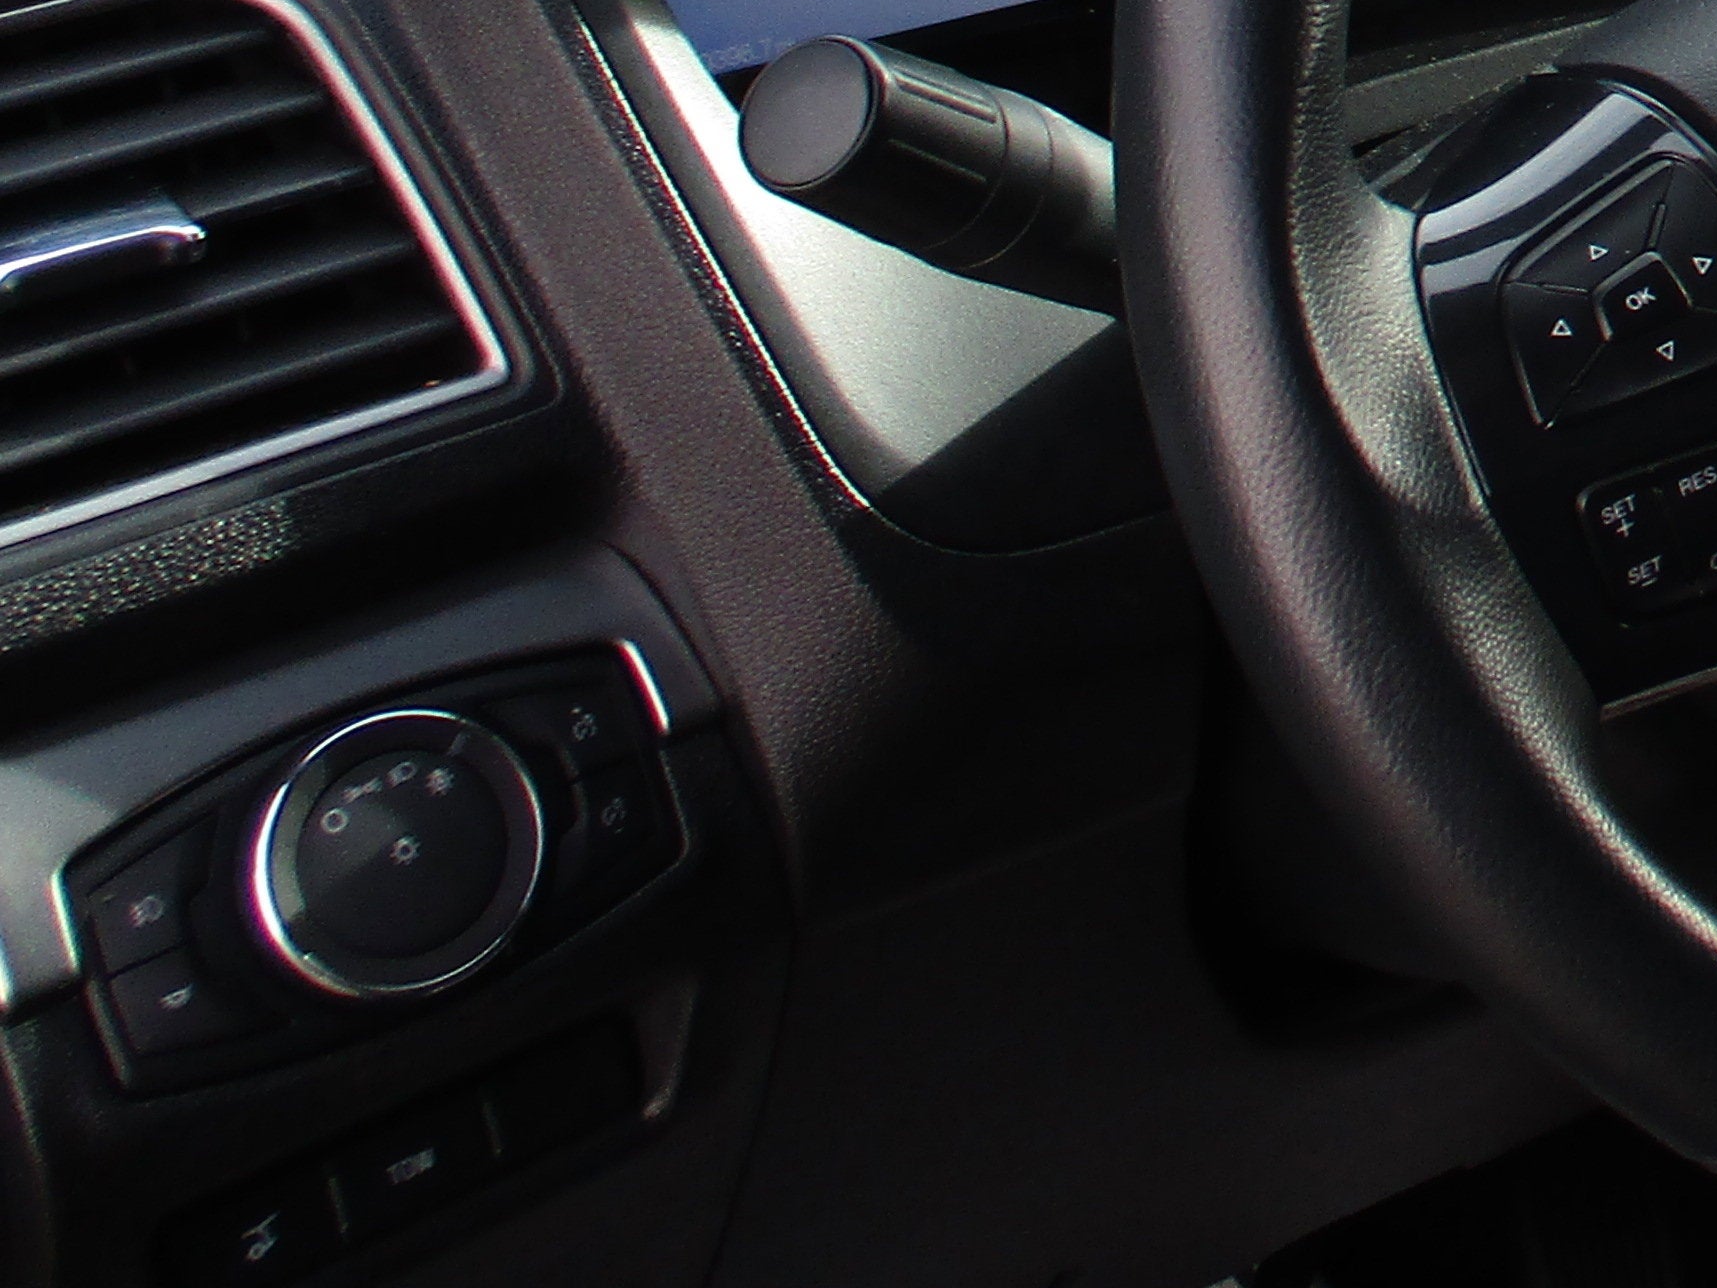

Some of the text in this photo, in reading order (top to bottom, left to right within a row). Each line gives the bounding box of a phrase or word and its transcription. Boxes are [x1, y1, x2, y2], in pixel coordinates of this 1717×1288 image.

[1623, 285, 1659, 312] OK
[1600, 493, 1638, 526] SET
[1627, 554, 1664, 586] SET
